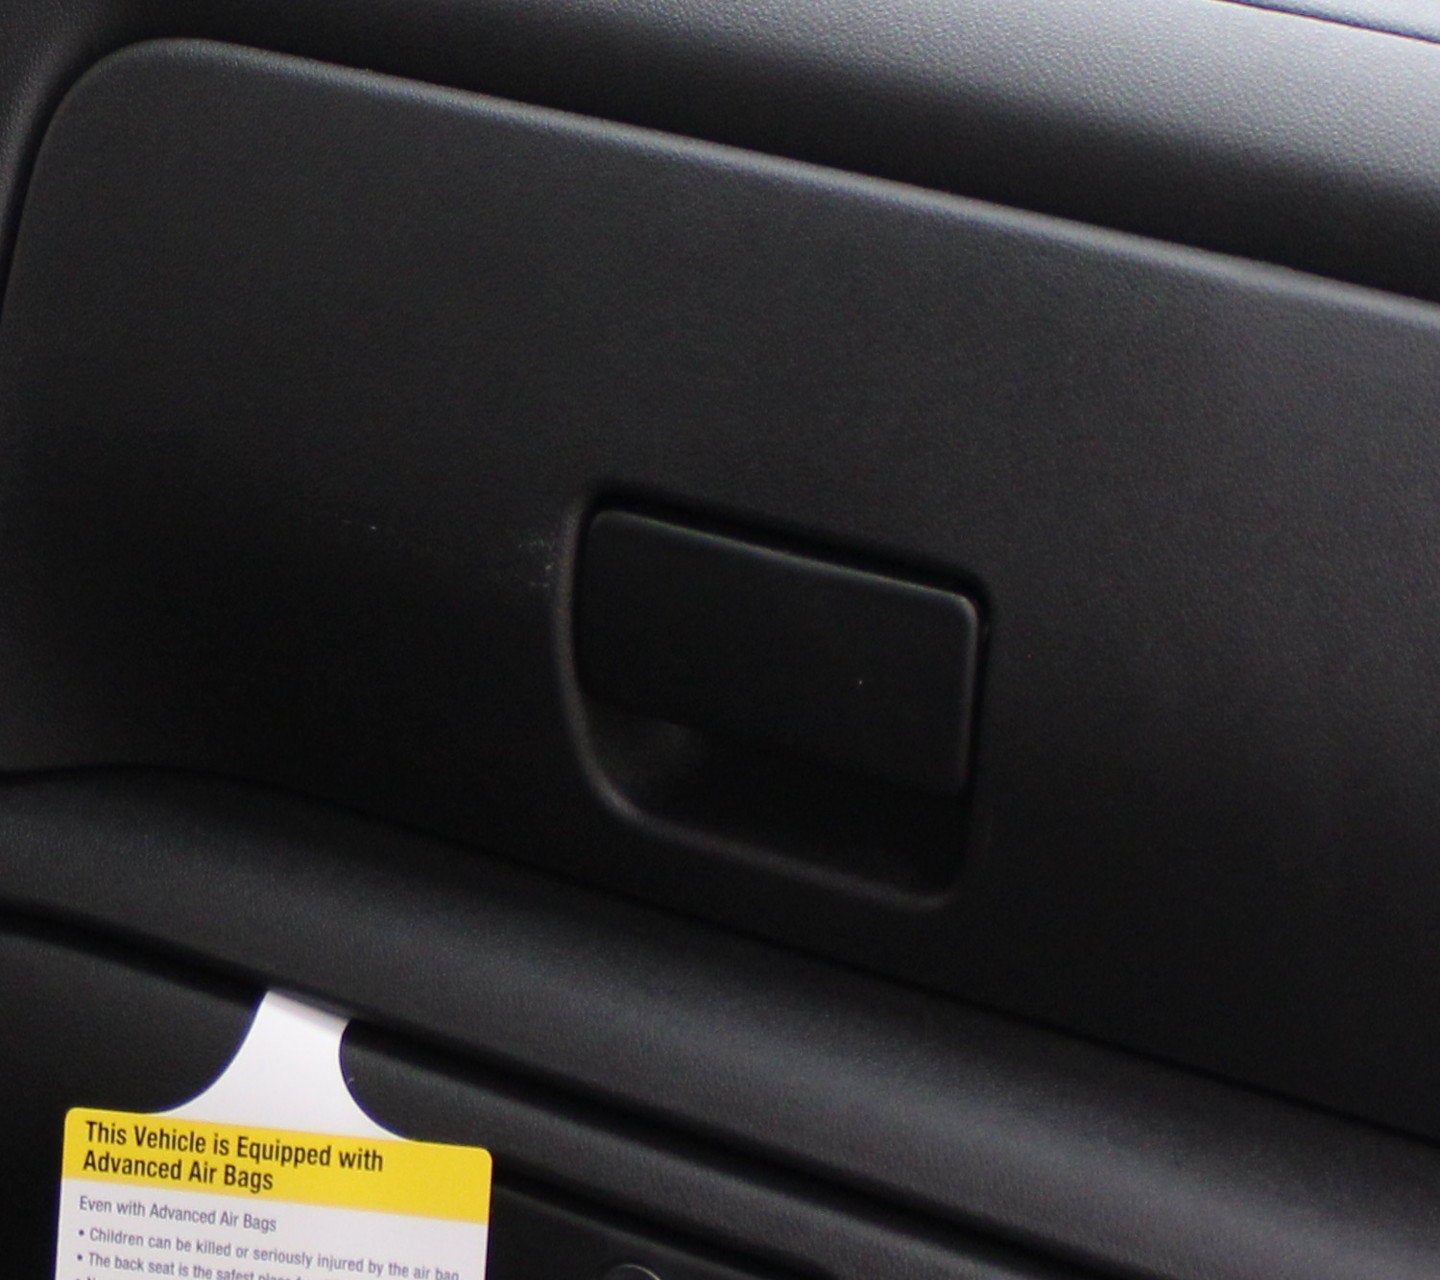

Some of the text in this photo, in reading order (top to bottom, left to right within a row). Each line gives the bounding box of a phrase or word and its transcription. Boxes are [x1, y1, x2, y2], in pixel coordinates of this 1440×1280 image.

[85, 1119, 383, 1171] This Vehicle is Equipped with
[82, 1149, 273, 1194] Advanced Air Bags
[78, 1194, 276, 1234] Even with Advanced Air Bags
[88, 1251, 111, 1268] The
[113, 1254, 144, 1271] back
[147, 1260, 175, 1275] seat
[177, 1262, 189, 1277] is
[192, 1264, 212, 1280] the
[89, 1226, 144, 1246] Children
[147, 1235, 171, 1249] can
[175, 1236, 191, 1252] be
[195, 1238, 231, 1257] killed
[234, 1246, 249, 1258] or
[252, 1247, 313, 1269] seriously
[316, 1253, 364, 1272] injured
[367, 1258, 383, 1277] by
[387, 1261, 409, 1277] the
[412, 1265, 430, 1279] air
